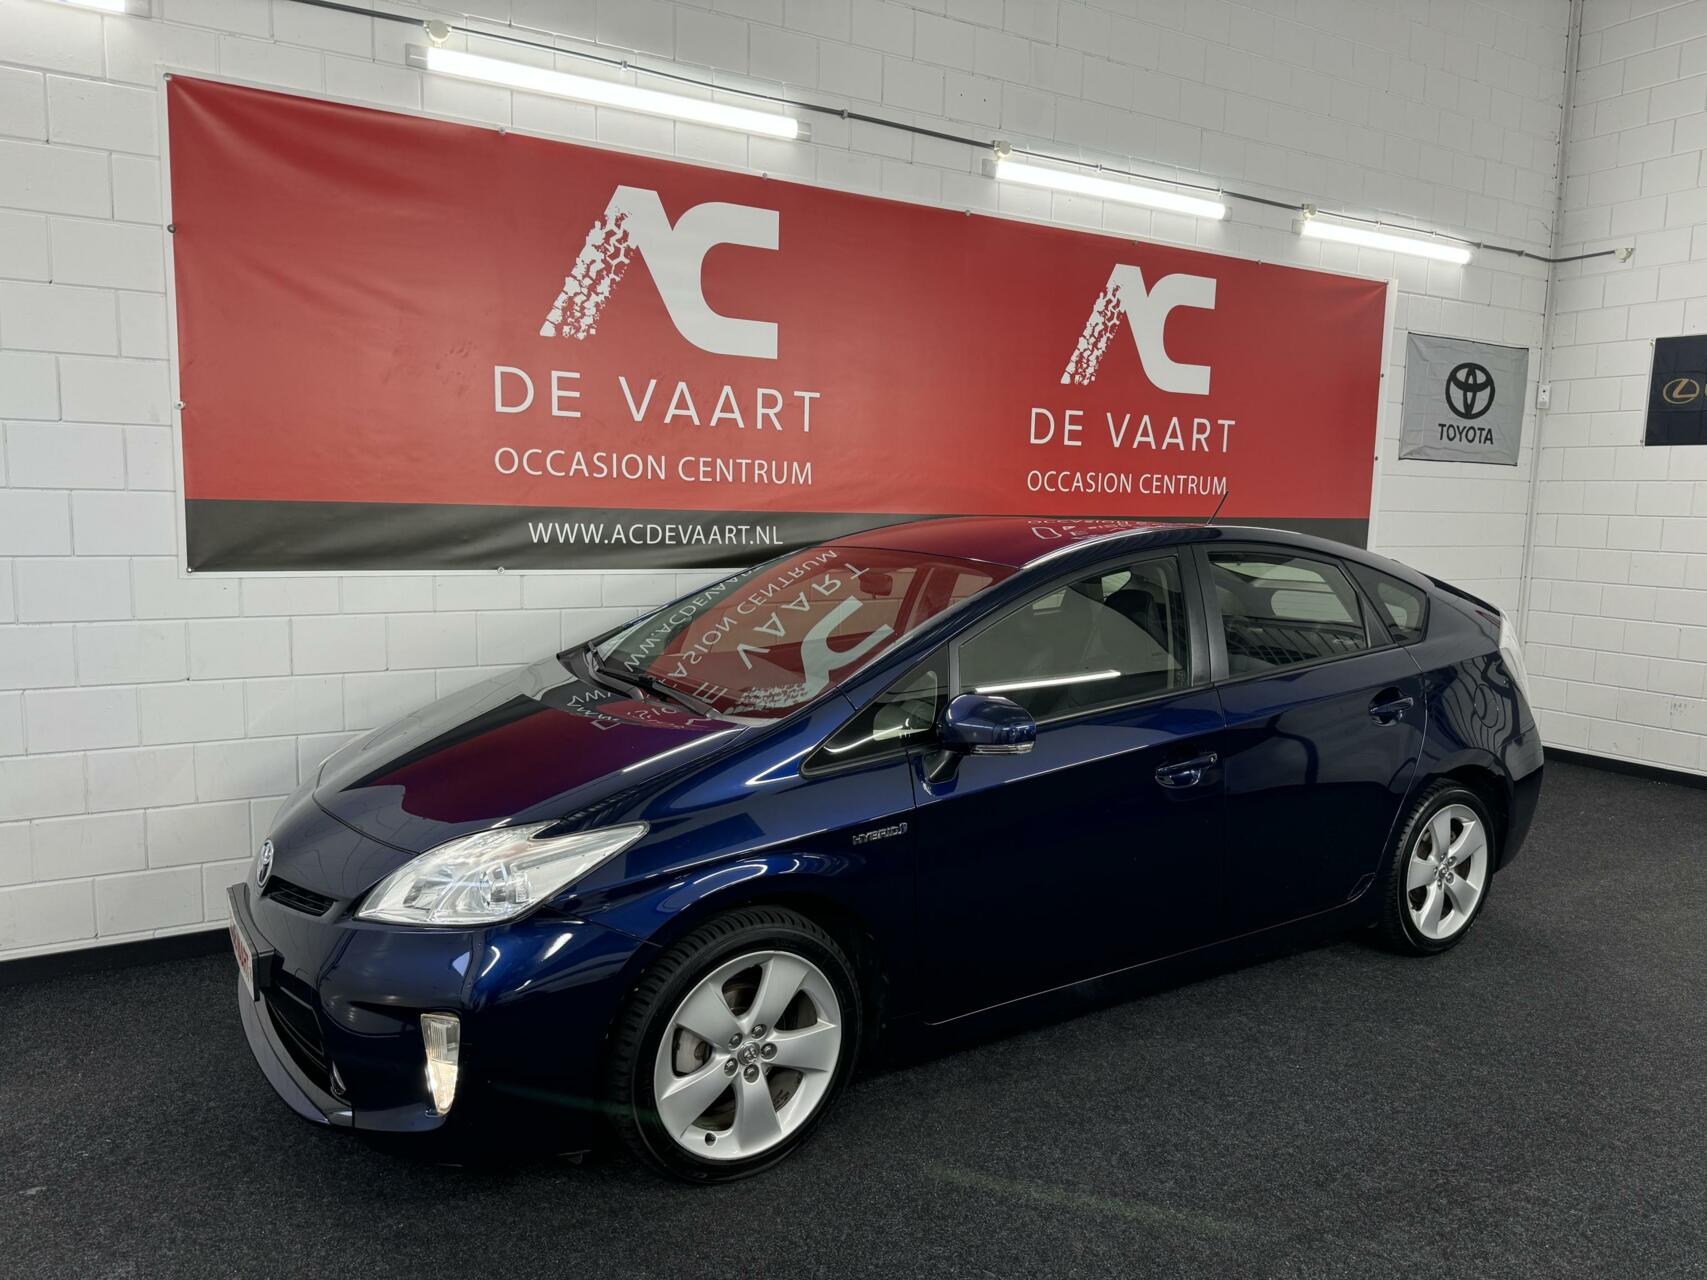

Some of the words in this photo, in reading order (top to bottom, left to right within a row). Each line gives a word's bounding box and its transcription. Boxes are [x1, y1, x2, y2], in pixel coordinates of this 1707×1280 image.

[539, 184, 780, 360] AC
[1060, 263, 1217, 396] AC
[493, 364, 582, 418] DE
[618, 375, 821, 433] VAART
[1029, 406, 1084, 446] DE
[1106, 412, 1236, 453] VAART
[1438, 423, 1494, 446] TOYOTA
[494, 447, 666, 480] OCCASION
[678, 456, 813, 485] CENTRUM
[1027, 470, 1132, 494] OCCASION
[1139, 473, 1228, 495] CENTRUM
[528, 522, 784, 545] WWW.ACDEVAART.NL
